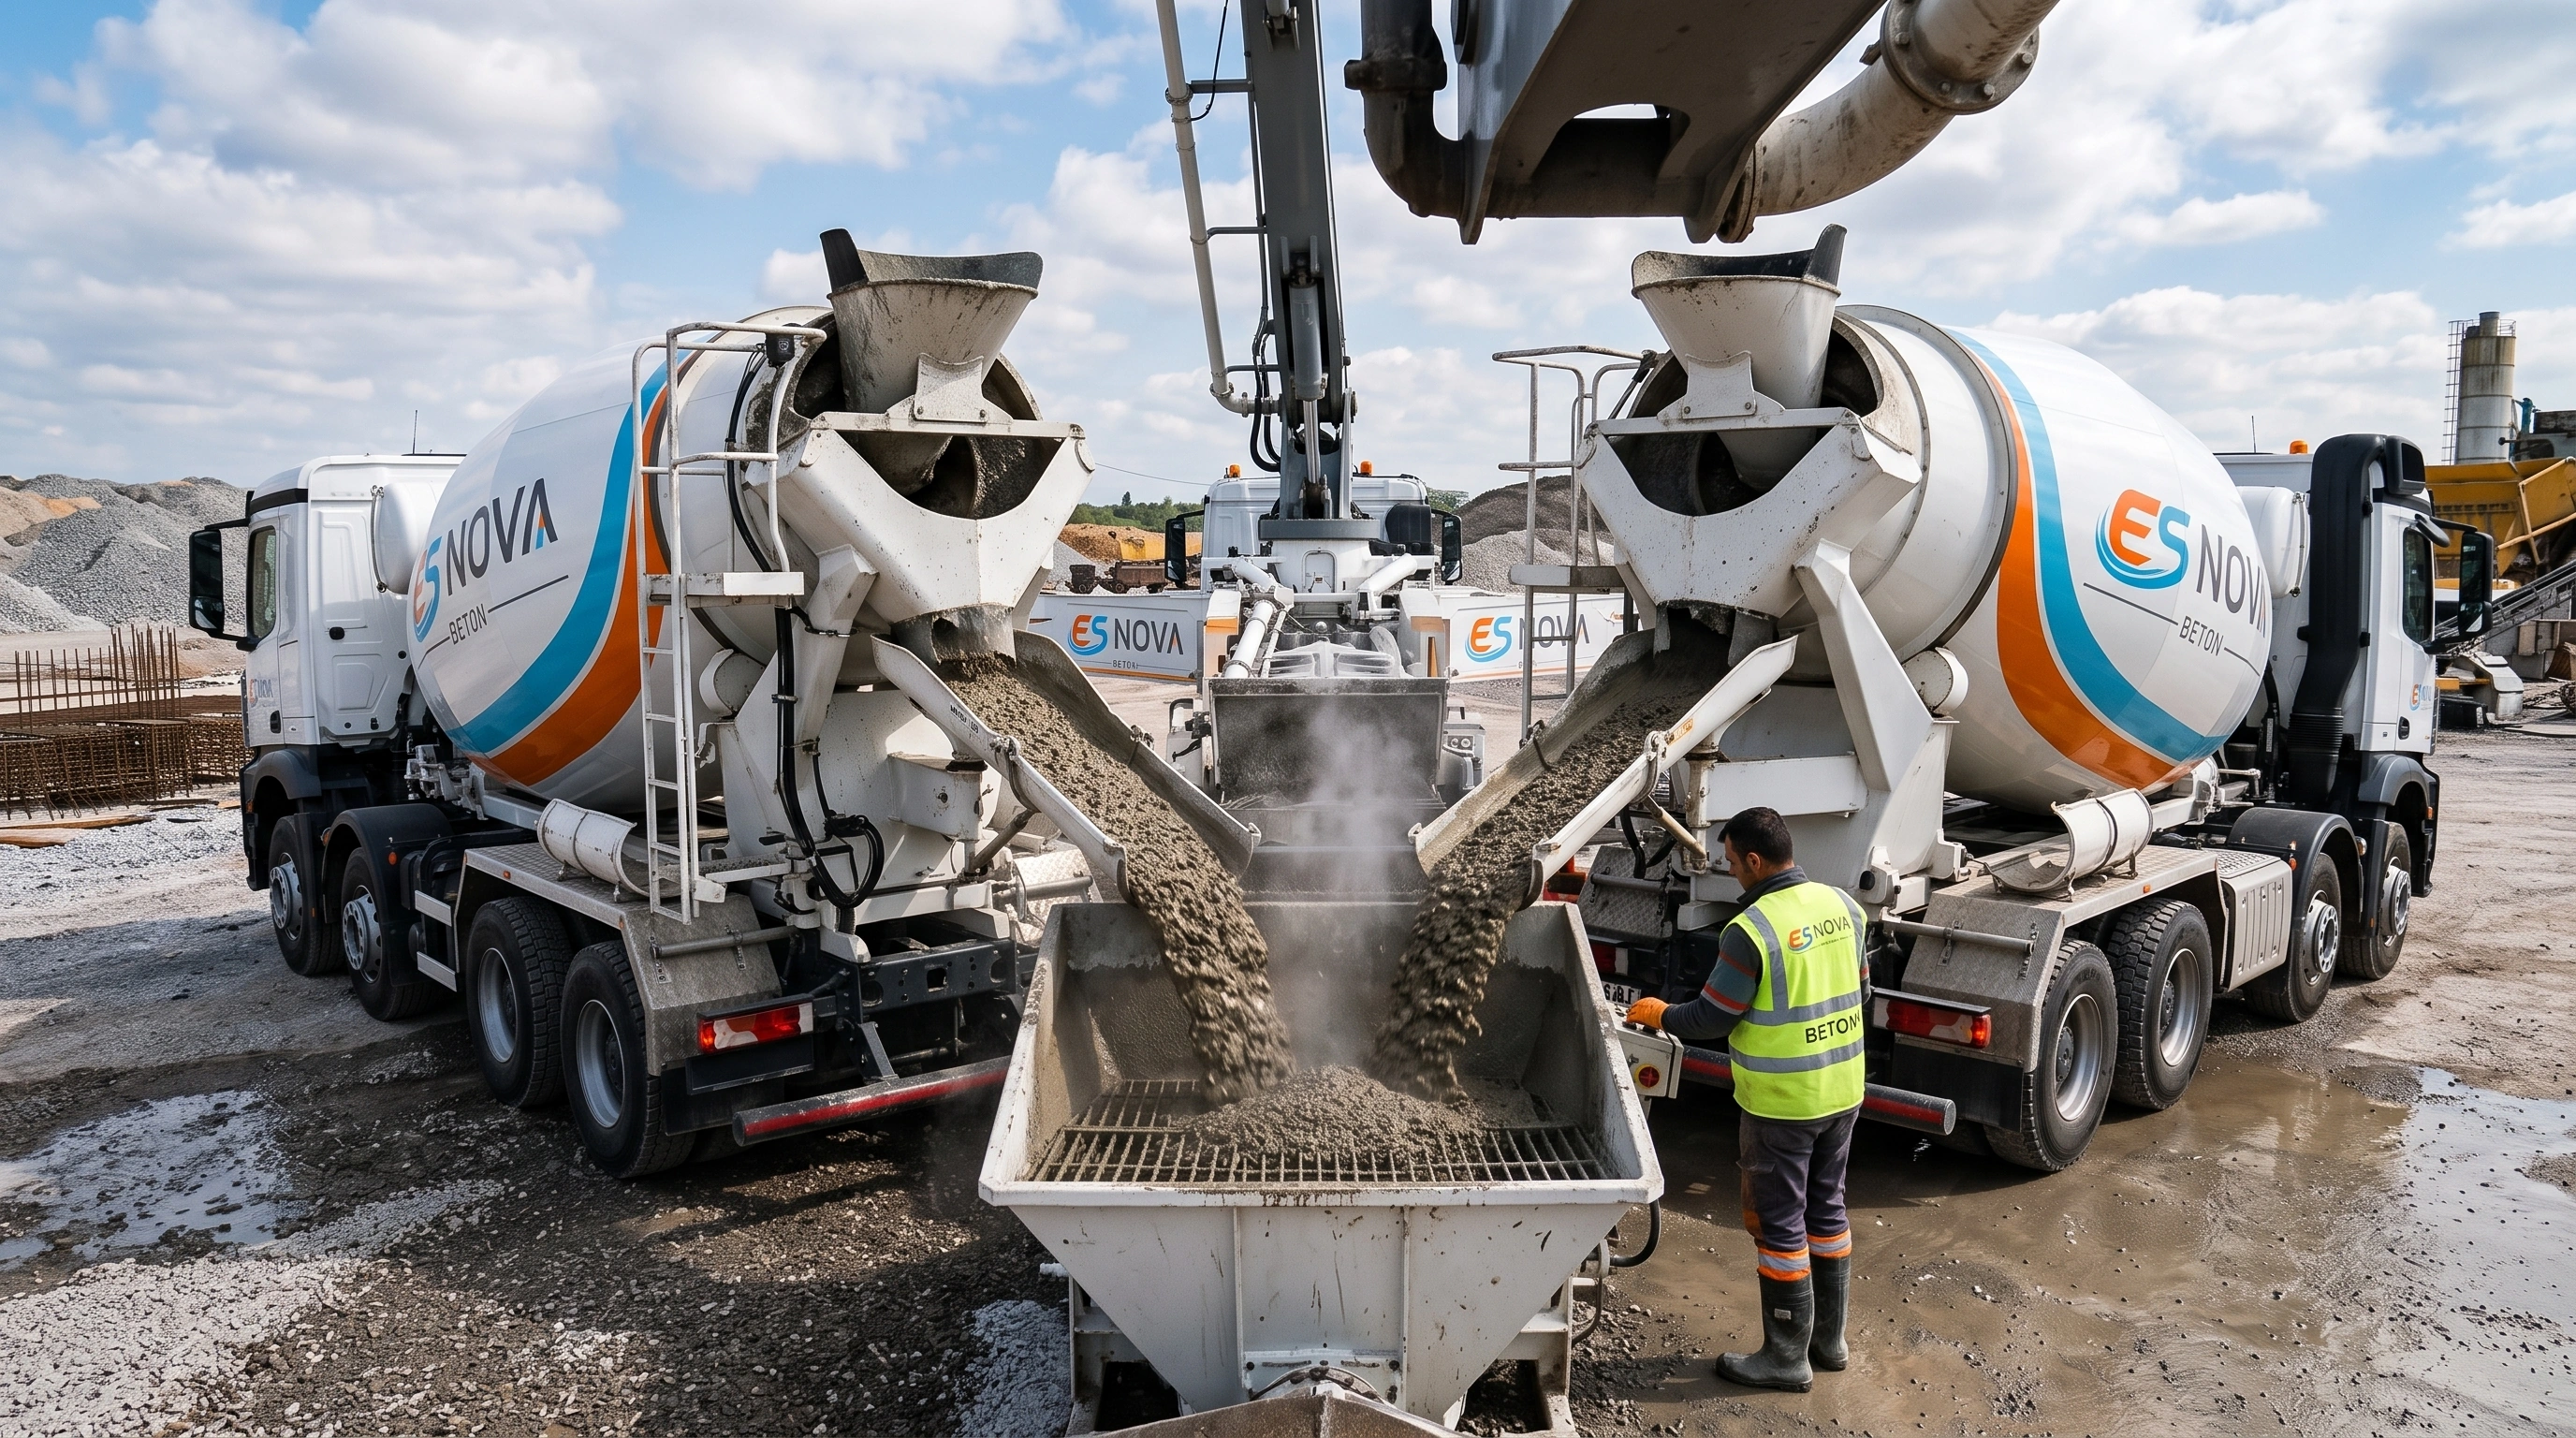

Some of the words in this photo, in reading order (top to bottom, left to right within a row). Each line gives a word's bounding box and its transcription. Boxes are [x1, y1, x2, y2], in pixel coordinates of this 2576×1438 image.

[413, 536, 443, 643] ES
[446, 477, 559, 596] NOVA
[2095, 489, 2191, 590] ES
[2196, 523, 2266, 638] NOVA
[448, 603, 488, 645] BETON
[1067, 614, 1108, 656] ES
[1114, 618, 1184, 655] NOVA
[1464, 615, 1513, 663] ES
[2178, 615, 2224, 657] BETON
[1788, 926, 1813, 953] ES
[1812, 916, 1852, 939] NOVA
